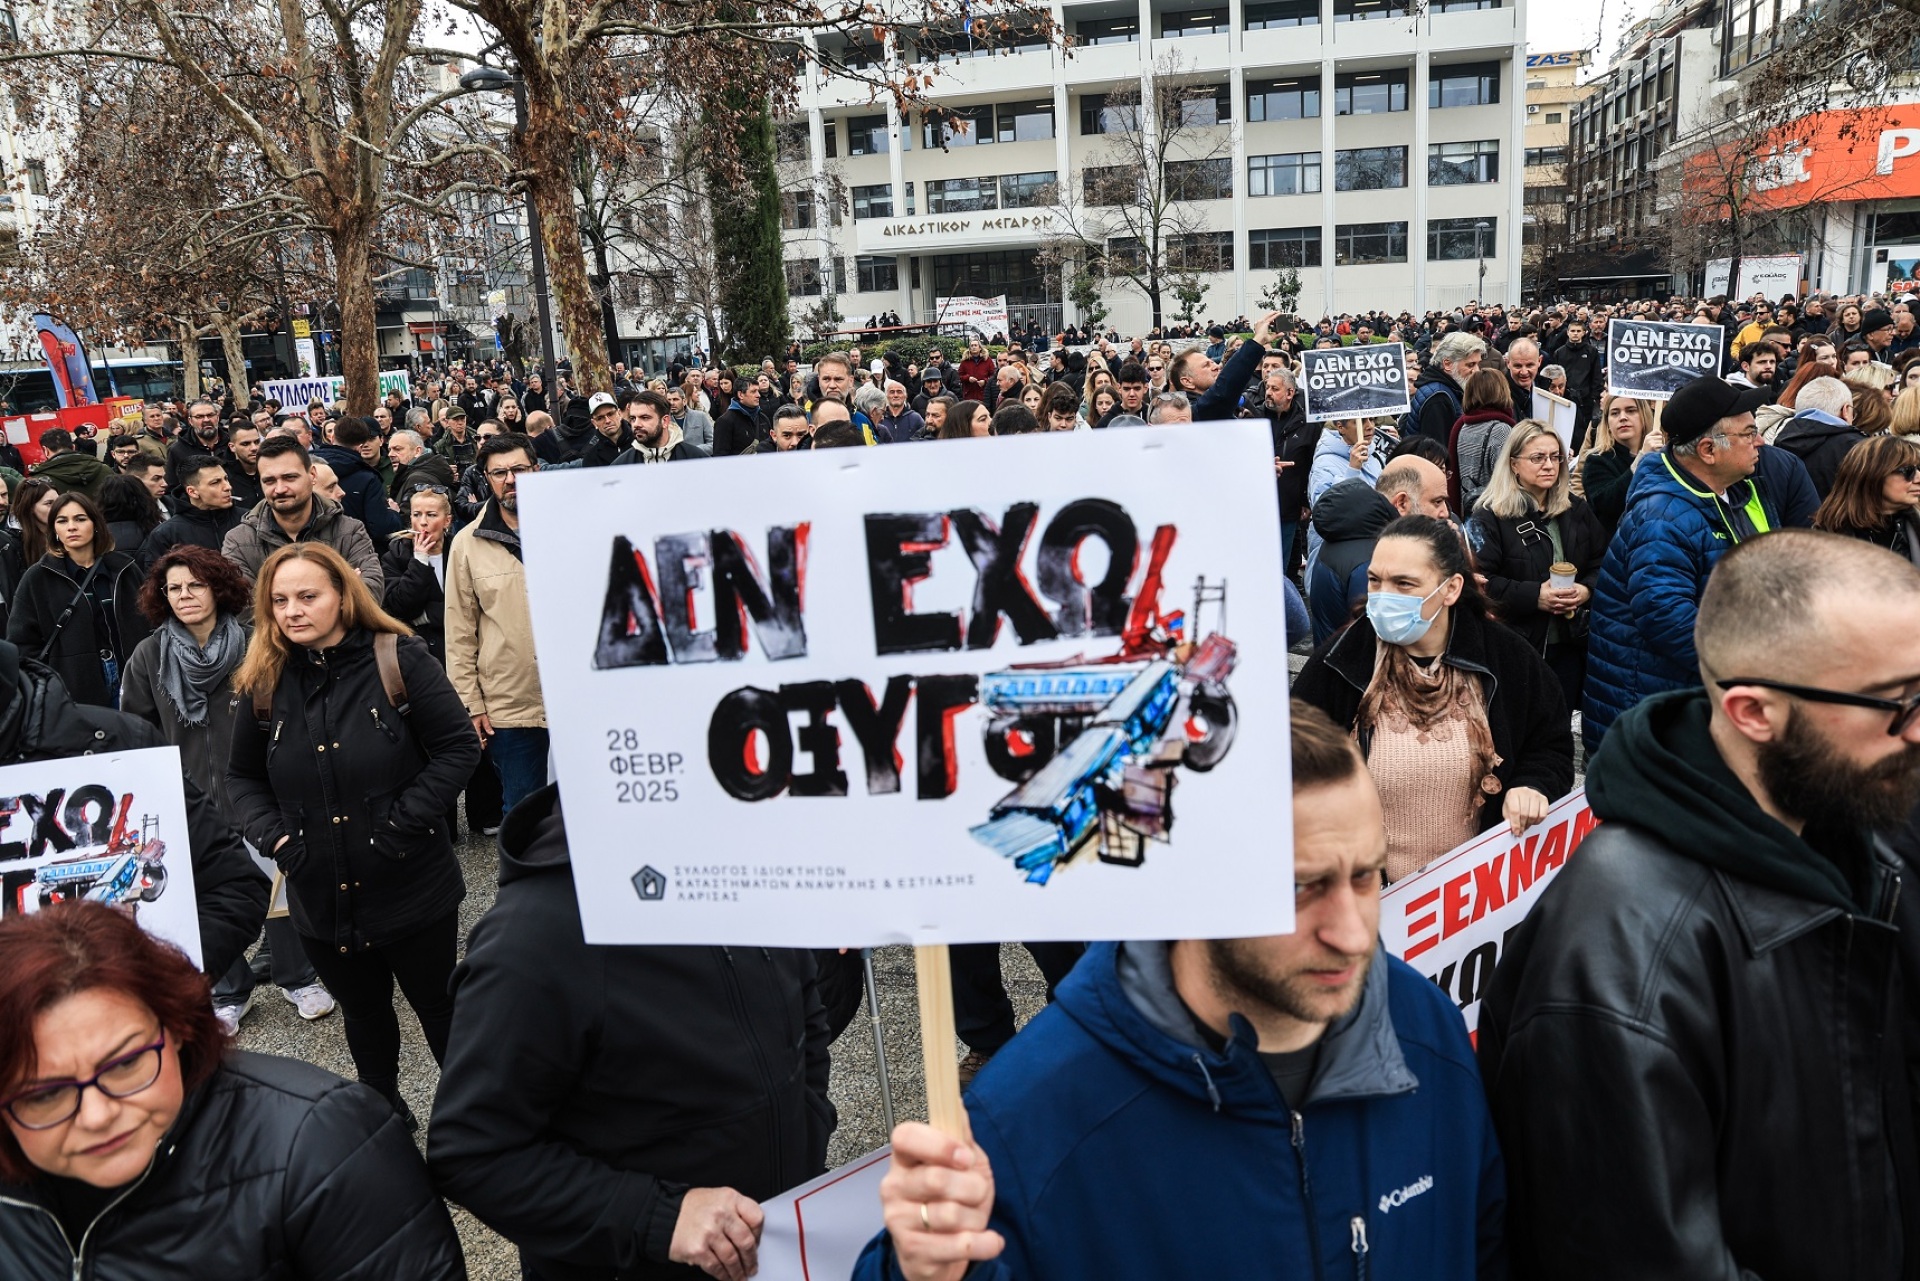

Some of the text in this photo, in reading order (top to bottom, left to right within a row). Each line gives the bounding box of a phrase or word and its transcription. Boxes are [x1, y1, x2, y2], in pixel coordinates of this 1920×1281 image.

[883, 215, 1054, 236] ΔΙΚΑΣΤΙΚΟΝ ΜΕΓΑΡΟΝ
[1620, 329, 1711, 351] ΔΕΝ ΕΧΩ
[1313, 352, 1395, 373] ΔΕΝ ΕΧΩ
[1614, 346, 1716, 369] ΟΞΥΓΟΝΟ
[1309, 367, 1401, 390] ΟΞΥΓΟΝΟ
[269, 382, 330, 407] ΣΥΛΛΟΓΟΣ
[592, 497, 1142, 671] ΔΕΝ ΕΧΩ
[606, 728, 639, 751] 28
[609, 752, 685, 776] ΦΕΒΡ.
[616, 780, 679, 803] 2025
[674, 865, 846, 877] ΣΥΛΛΟΓΟΣ ΙΔΙΟΚΤΗΤΩΝ
[674, 874, 973, 890] ΚΑΤΑΣΤΗΜΑΤΩΝ ΑΝΑΨΥΧΗΣ & ΕΣΤΙΑΣΗΣ
[677, 891, 740, 902] ΛΑΡΙΣΑΣ
[1389, 1175, 1434, 1207] Columbia
